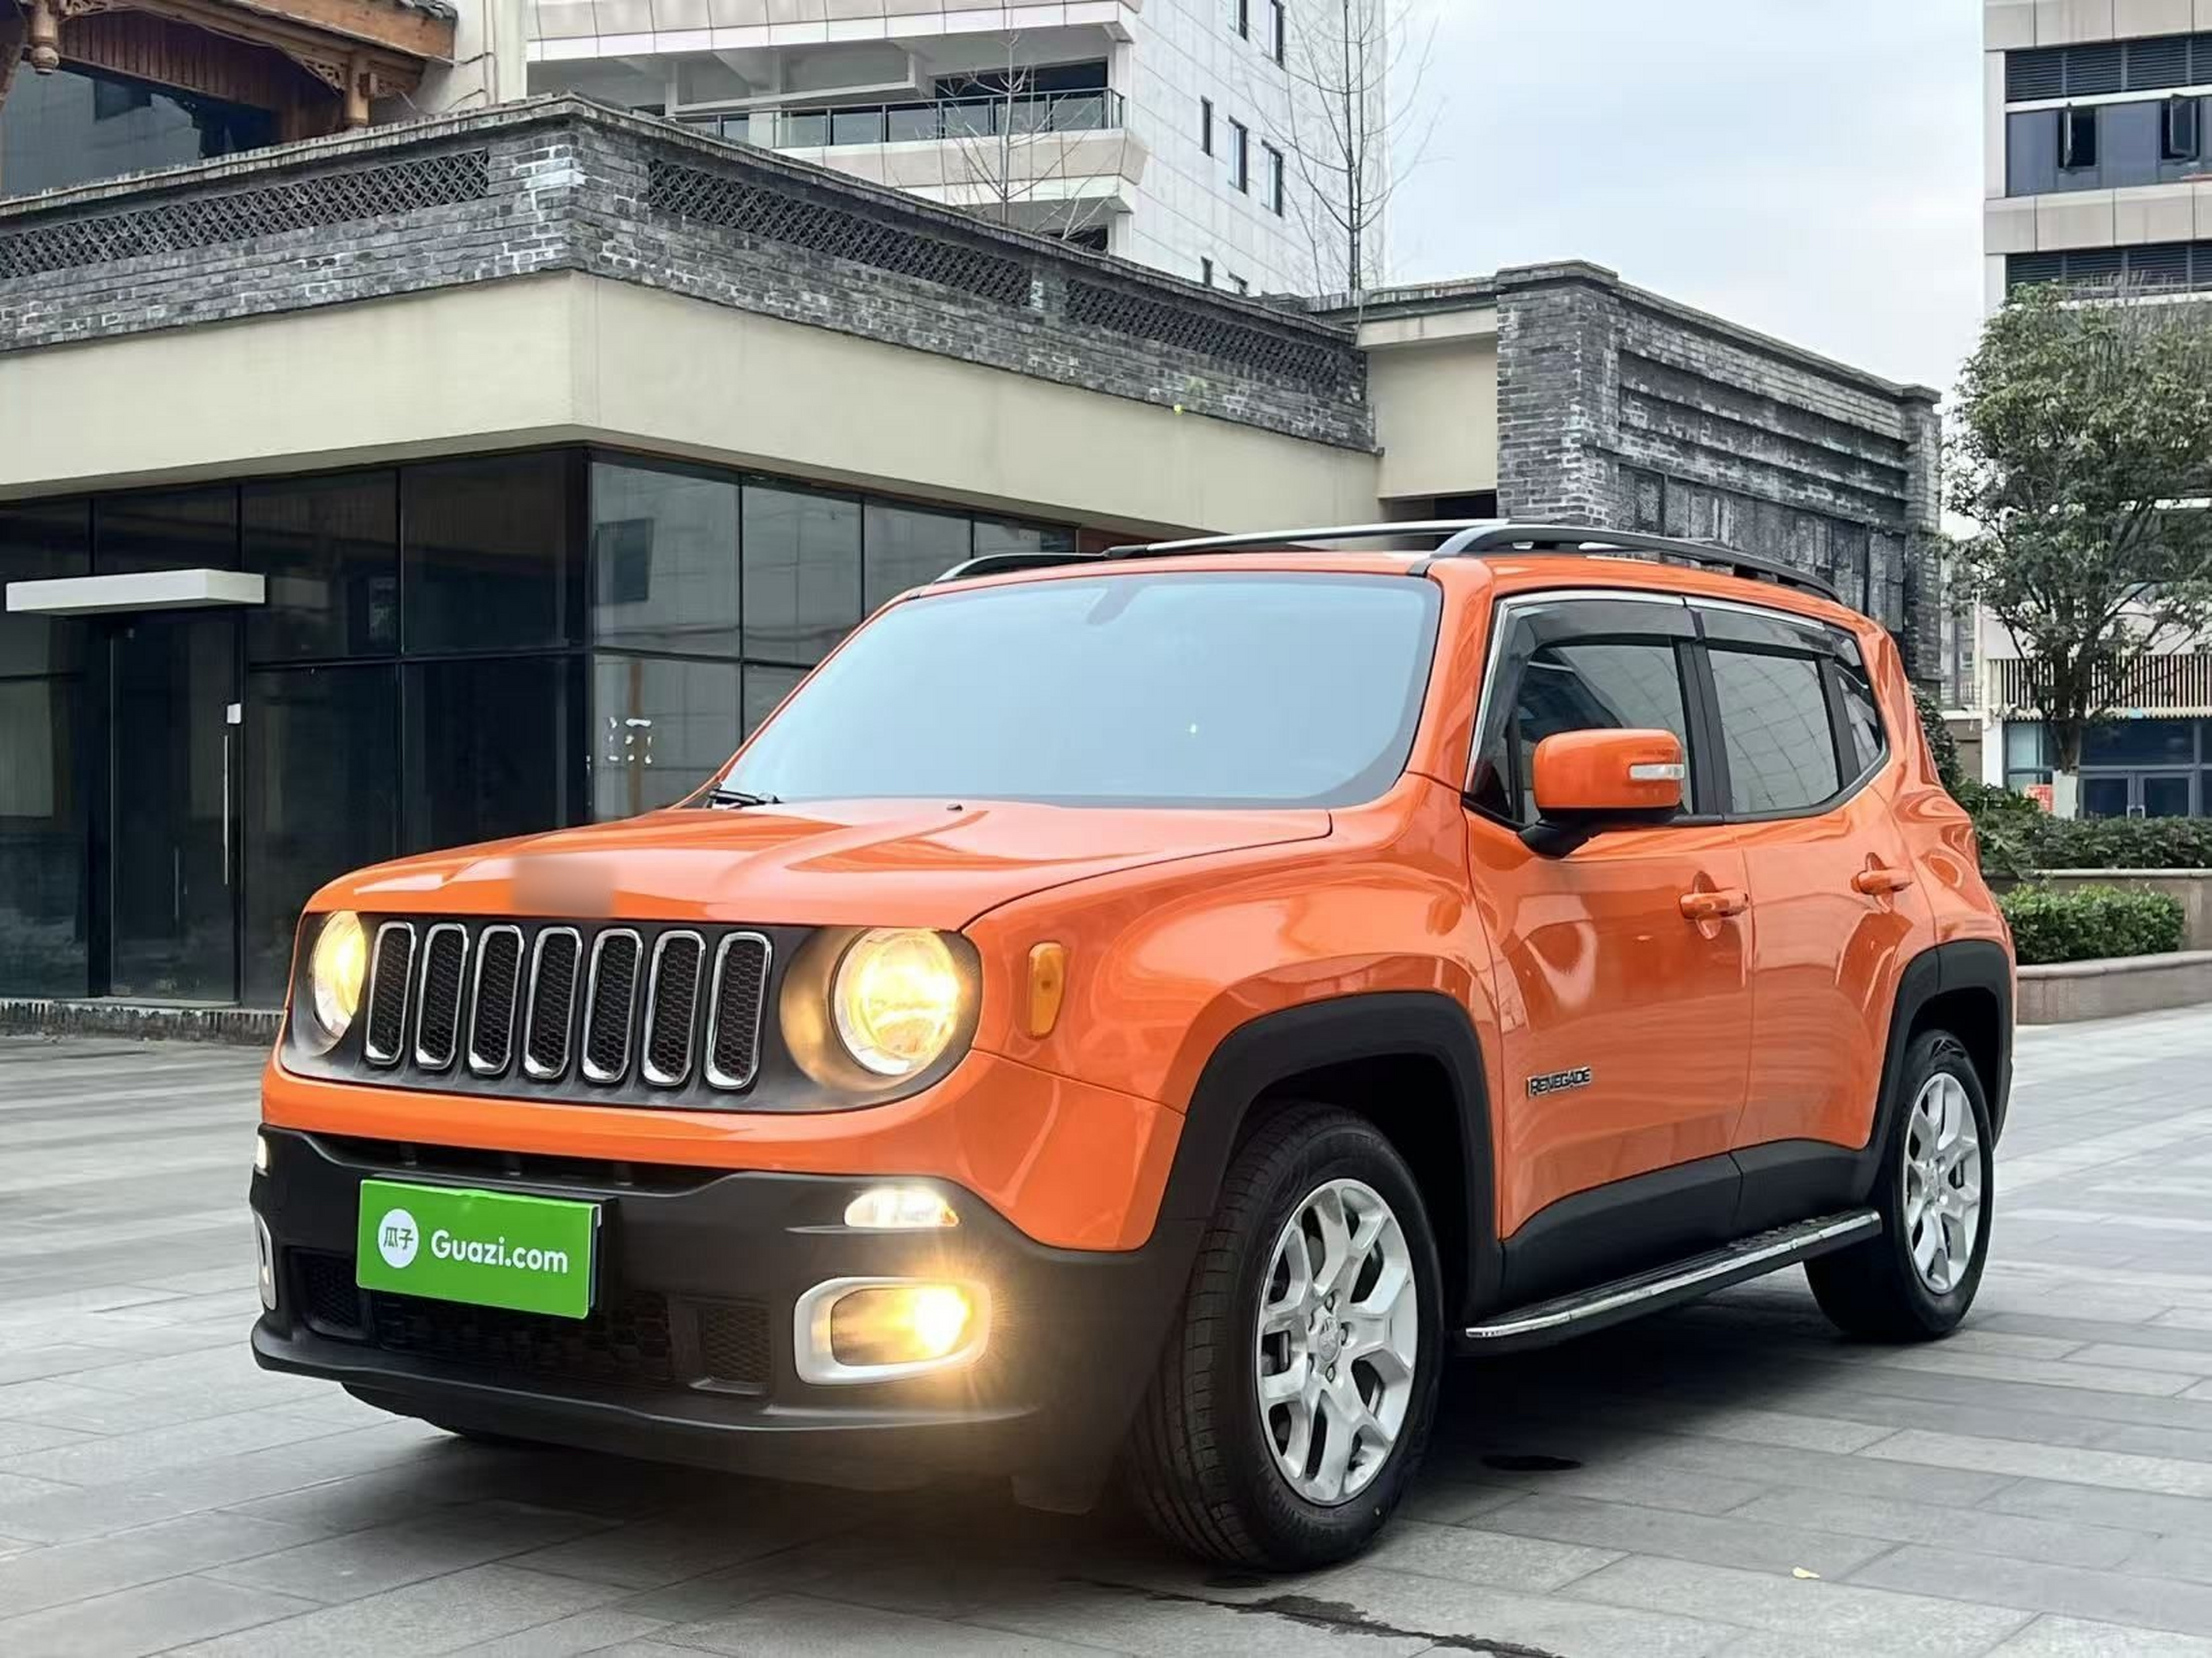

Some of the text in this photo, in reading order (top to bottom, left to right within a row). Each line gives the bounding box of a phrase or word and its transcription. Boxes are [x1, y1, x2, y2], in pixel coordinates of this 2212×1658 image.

[1528, 1067, 1591, 1097] RENEGADE
[383, 1226, 414, 1250] 瓜子
[430, 1229, 568, 1273] Guazi.com
